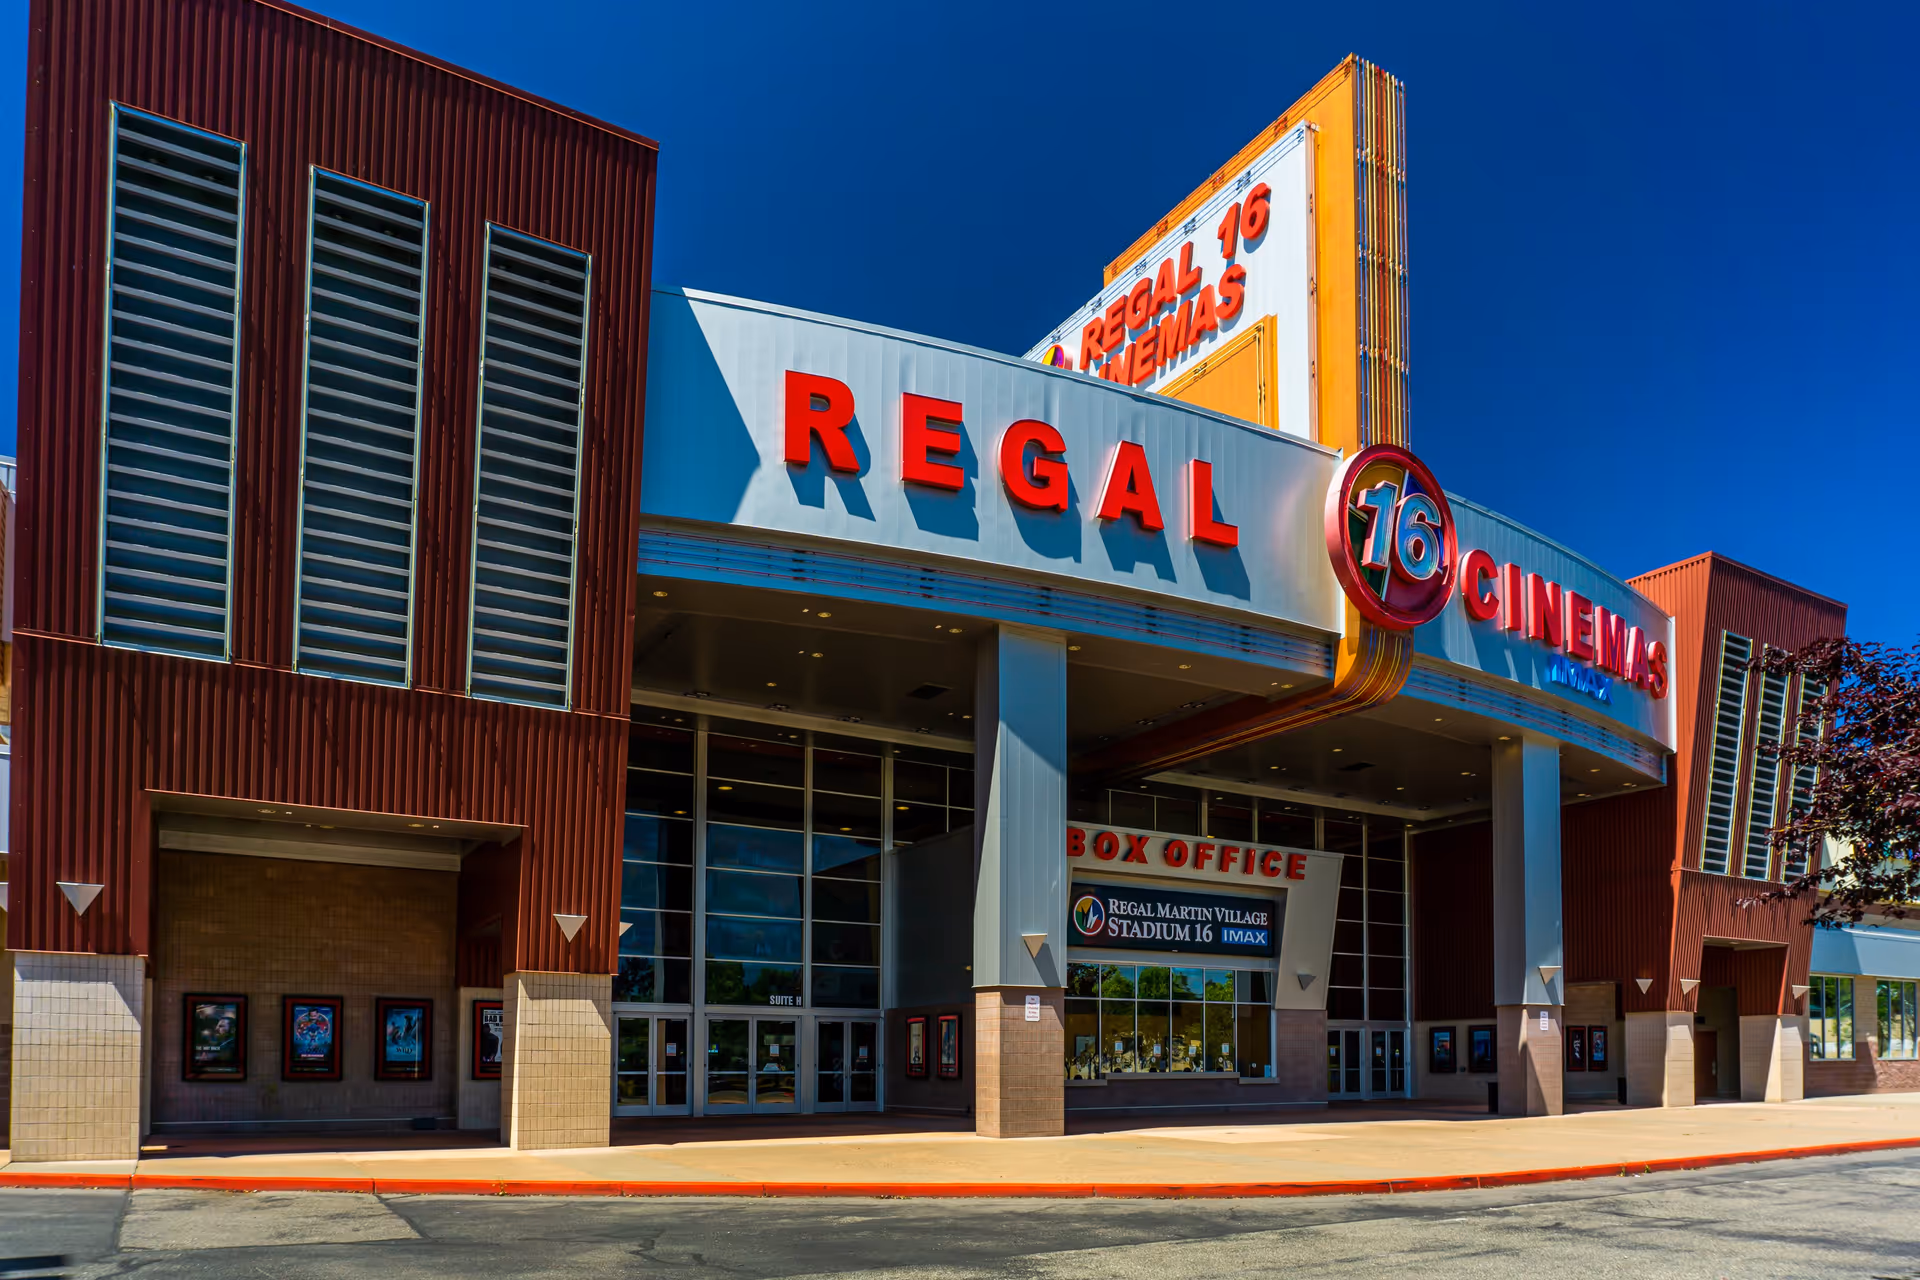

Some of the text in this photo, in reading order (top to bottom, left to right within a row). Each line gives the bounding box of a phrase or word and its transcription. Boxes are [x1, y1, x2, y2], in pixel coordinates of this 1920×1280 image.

[1079, 182, 1271, 371] REGAL 16
[783, 369, 1239, 548] REGAL
[1356, 480, 1442, 583] 16
[1460, 549, 1669, 700] CINEMAS
[1549, 653, 1616, 706] IMAX
[1066, 827, 1308, 881] BOX OFFICE
[1108, 898, 1269, 926] REGAL MARTIN VILLAGE
[1108, 916, 1214, 943] STADIUM 16
[1223, 929, 1267, 944] IMAX
[769, 994, 802, 1006] SUITE H
